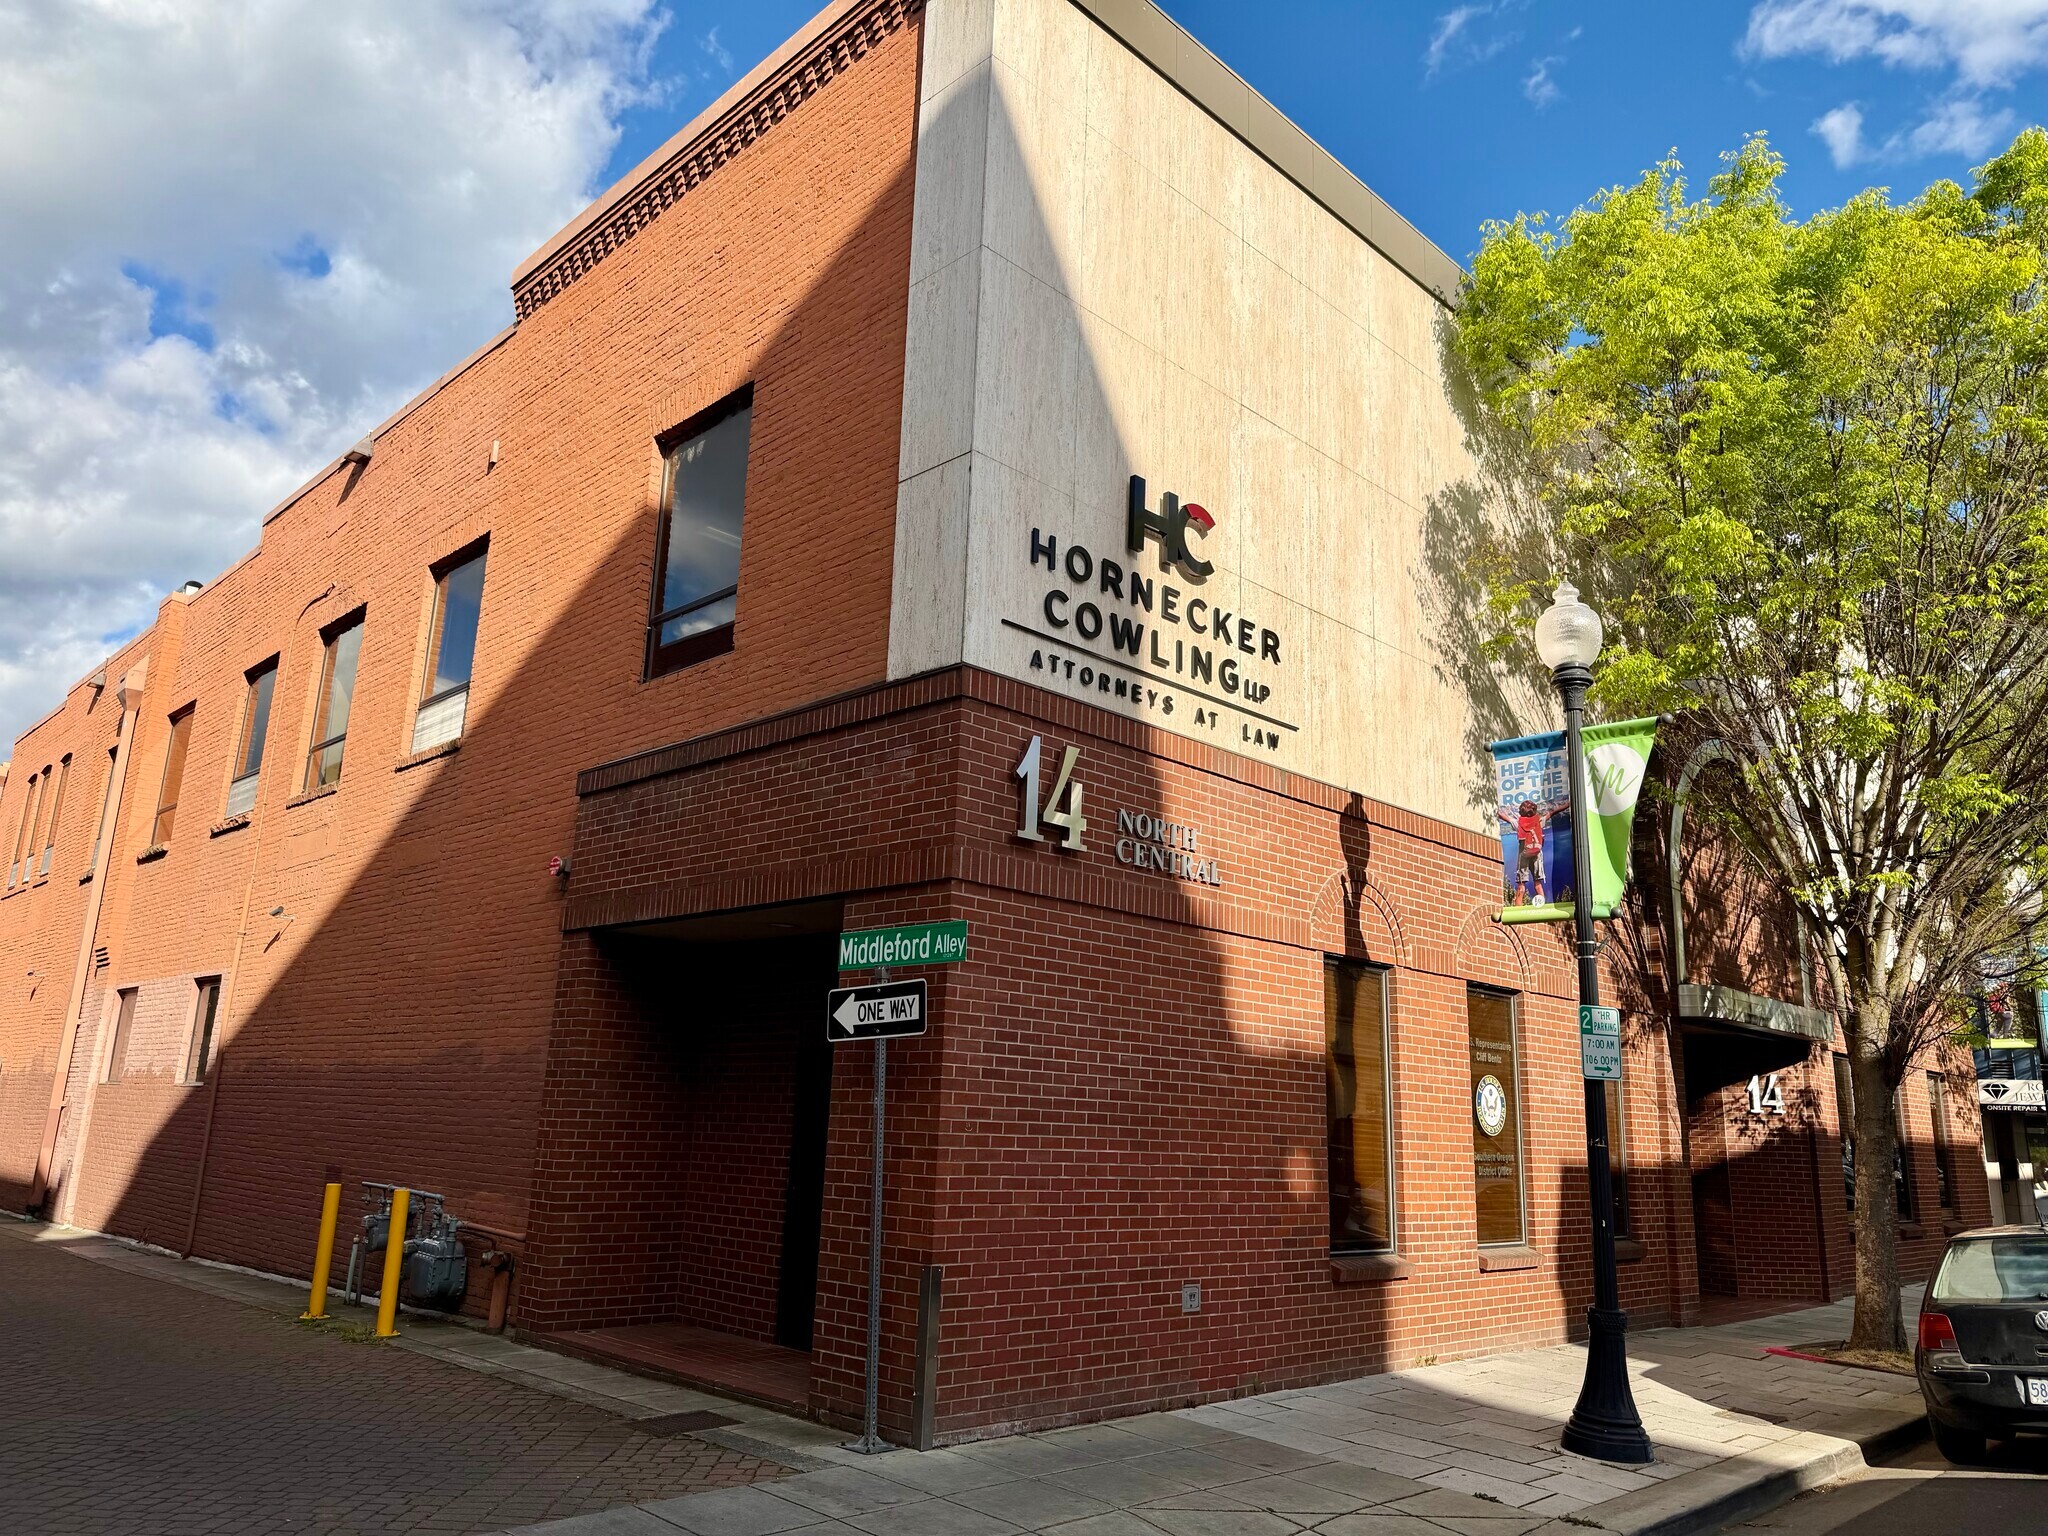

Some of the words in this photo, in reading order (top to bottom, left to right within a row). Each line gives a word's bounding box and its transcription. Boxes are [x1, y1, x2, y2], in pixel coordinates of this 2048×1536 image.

[1128, 474, 1216, 579] HC
[1030, 527, 1282, 665] HORNECKER
[1044, 589, 1240, 694] COWLING
[1243, 678, 1271, 704] LLP
[1029, 649, 1174, 716] ATTORNEYS
[1193, 706, 1219, 731] AT
[1241, 723, 1280, 751] LAW
[1501, 755, 1562, 777] HEART
[1501, 776, 1525, 792] OF
[1527, 770, 1563, 788] THE
[1014, 734, 1088, 852] 14
[1502, 785, 1564, 806] ROGUE
[1117, 807, 1199, 853] NORTH
[1115, 838, 1223, 886] CENTRAL
[839, 929, 931, 966] Middleford
[934, 933, 967, 958] Alley
[857, 1001, 885, 1022] ONE
[889, 997, 916, 1019] WAY
[1581, 1011, 1591, 1029] 2
[1600, 1011, 1611, 1021] HR
[1593, 1021, 1617, 1033] PARKING
[1475, 1037, 1512, 1052] Representative
[1587, 1038, 1605, 1050] 7:00
[1606, 1040, 1615, 1050] AM
[1585, 1054, 1593, 1065] TO
[1610, 1056, 1619, 1067] PM
[1746, 1074, 1787, 1115] 14
